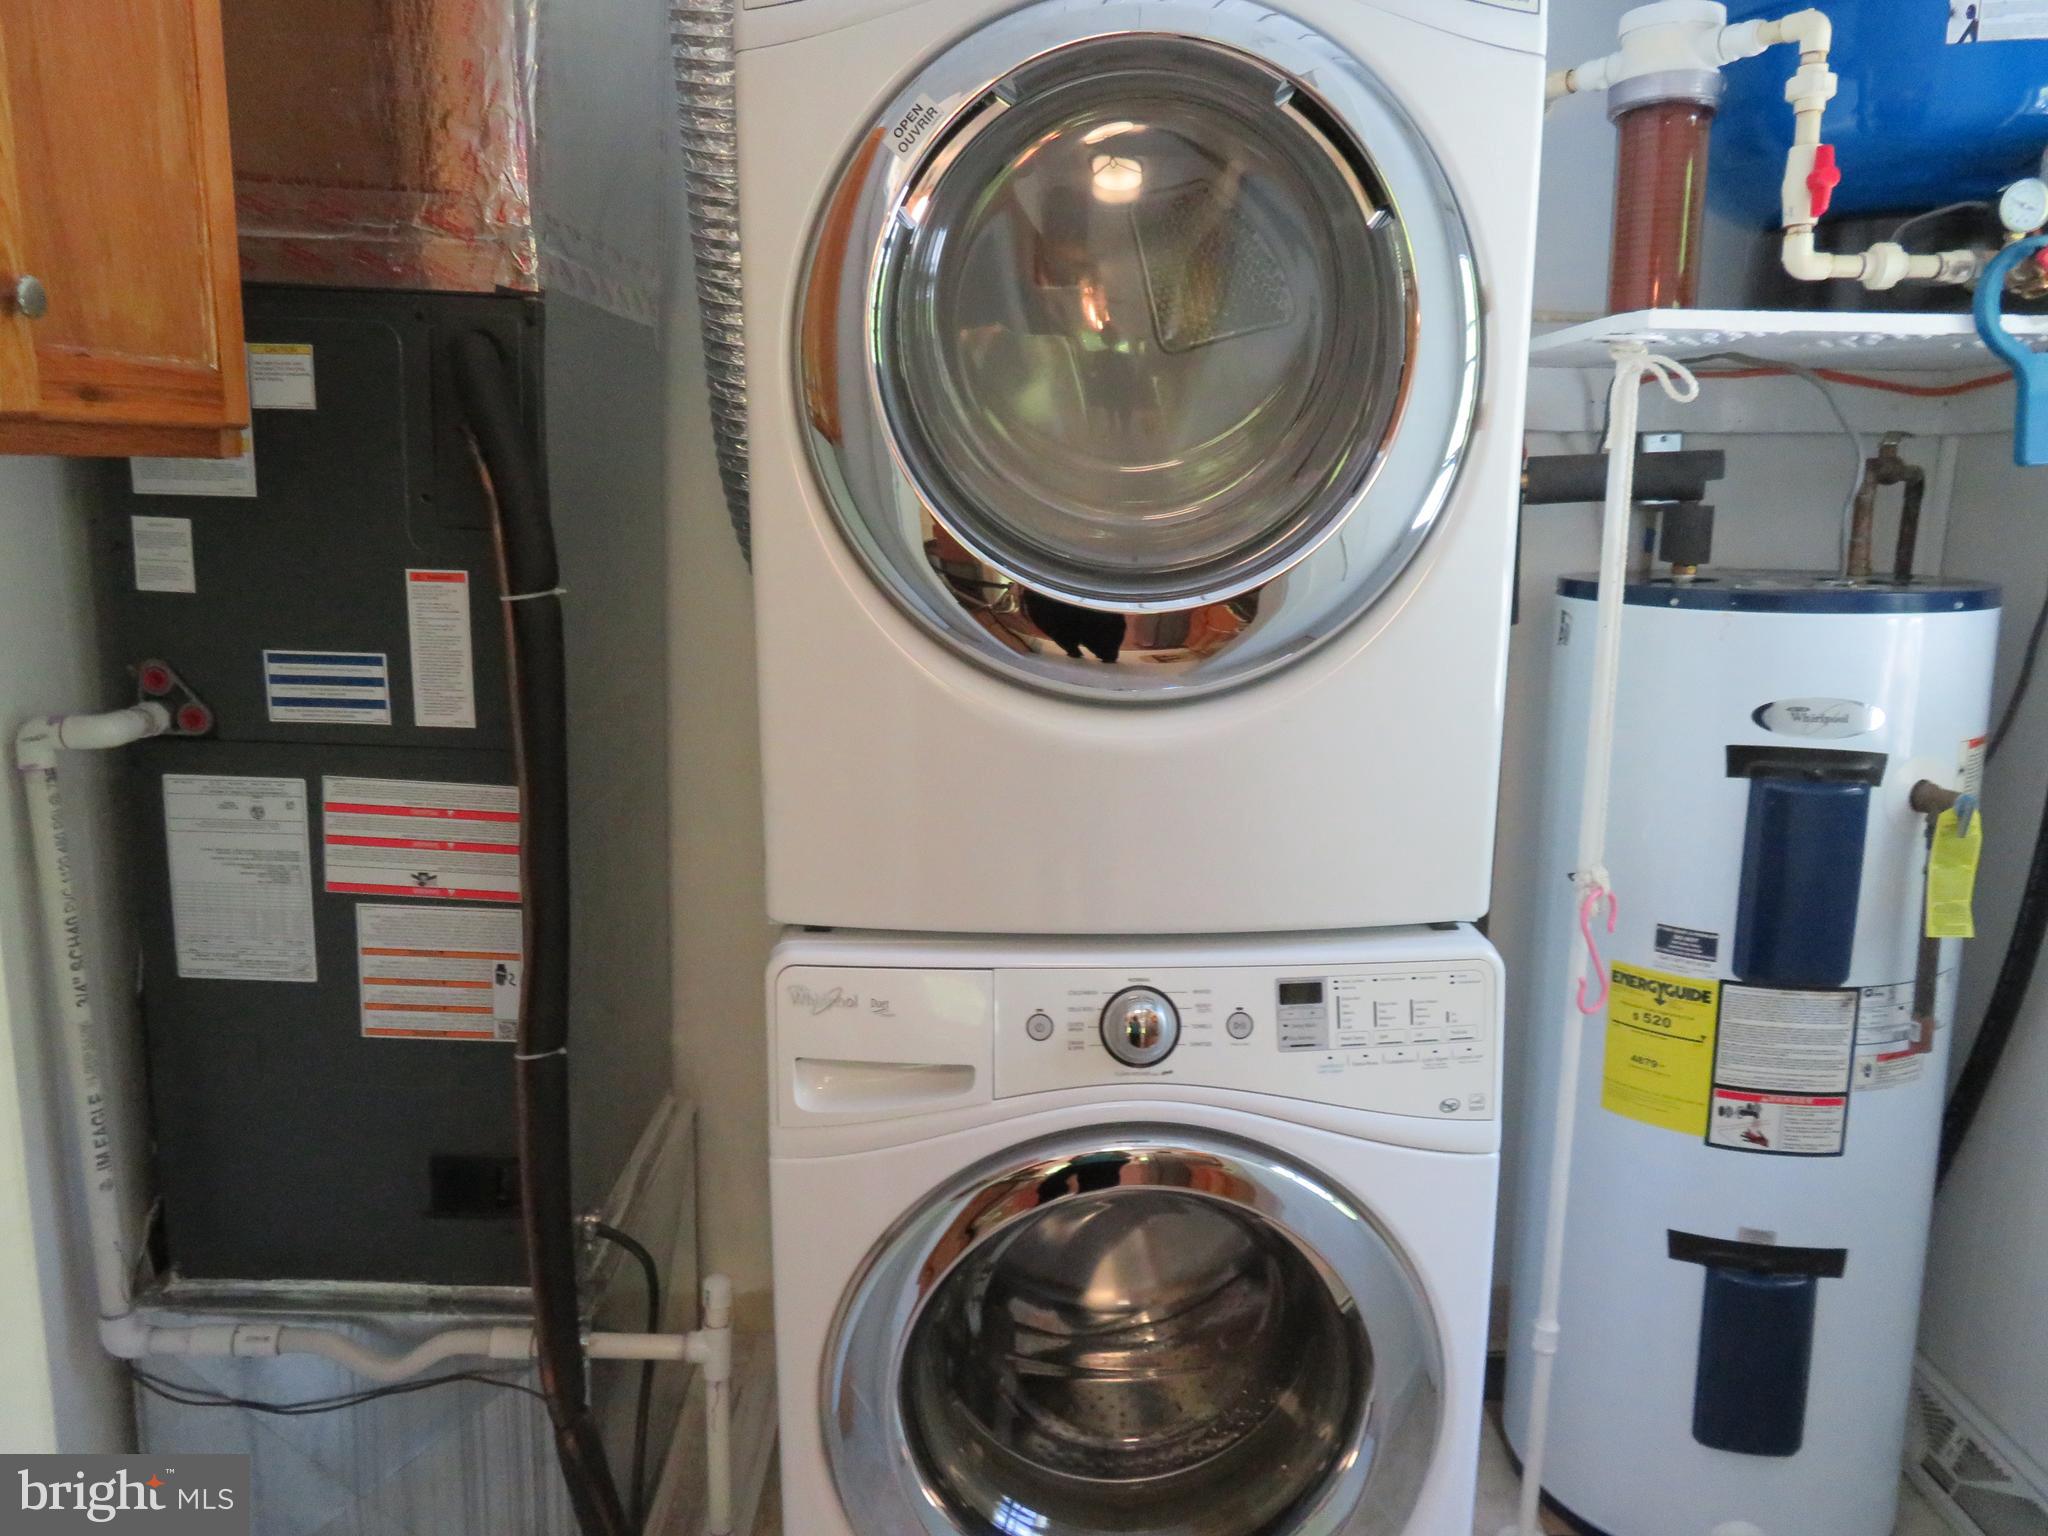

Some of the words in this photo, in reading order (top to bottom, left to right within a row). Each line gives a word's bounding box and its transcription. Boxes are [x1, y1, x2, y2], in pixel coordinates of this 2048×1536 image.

[893, 103, 924, 138] OPEN
[898, 107, 938, 153] OUVRIR
[1790, 711, 1849, 727] Whirlpool
[1611, 969, 1713, 1004] ENERGYGUIDE
[1642, 1012, 1672, 1029] 520
